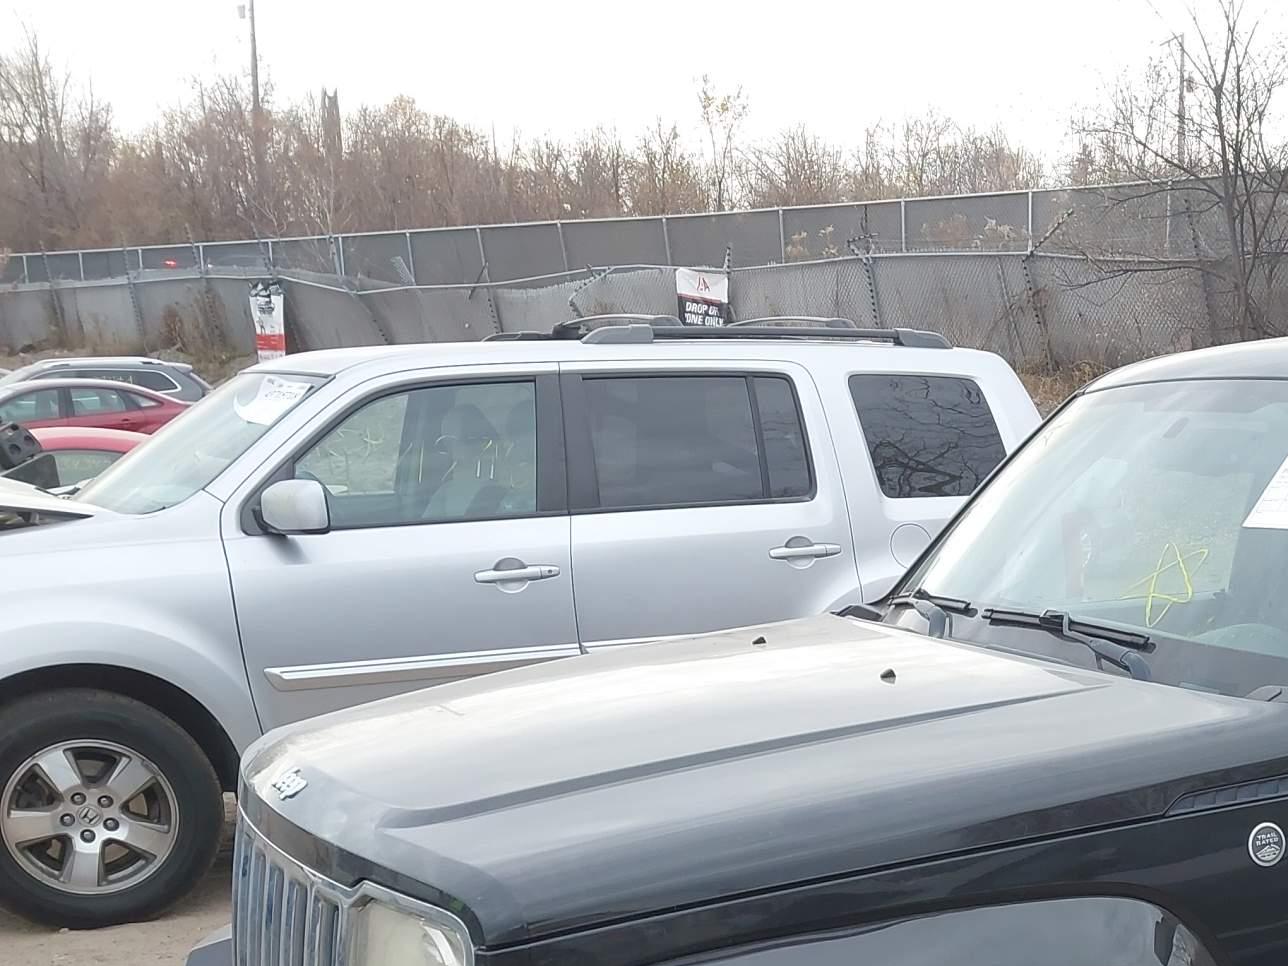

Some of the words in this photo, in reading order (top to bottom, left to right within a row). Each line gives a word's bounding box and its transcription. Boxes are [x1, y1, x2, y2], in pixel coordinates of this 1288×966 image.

[686, 302, 708, 314] DROP
[705, 316, 724, 327] ONLY
[1256, 832, 1278, 841] TRAIL
[1255, 837, 1279, 847] RATED
